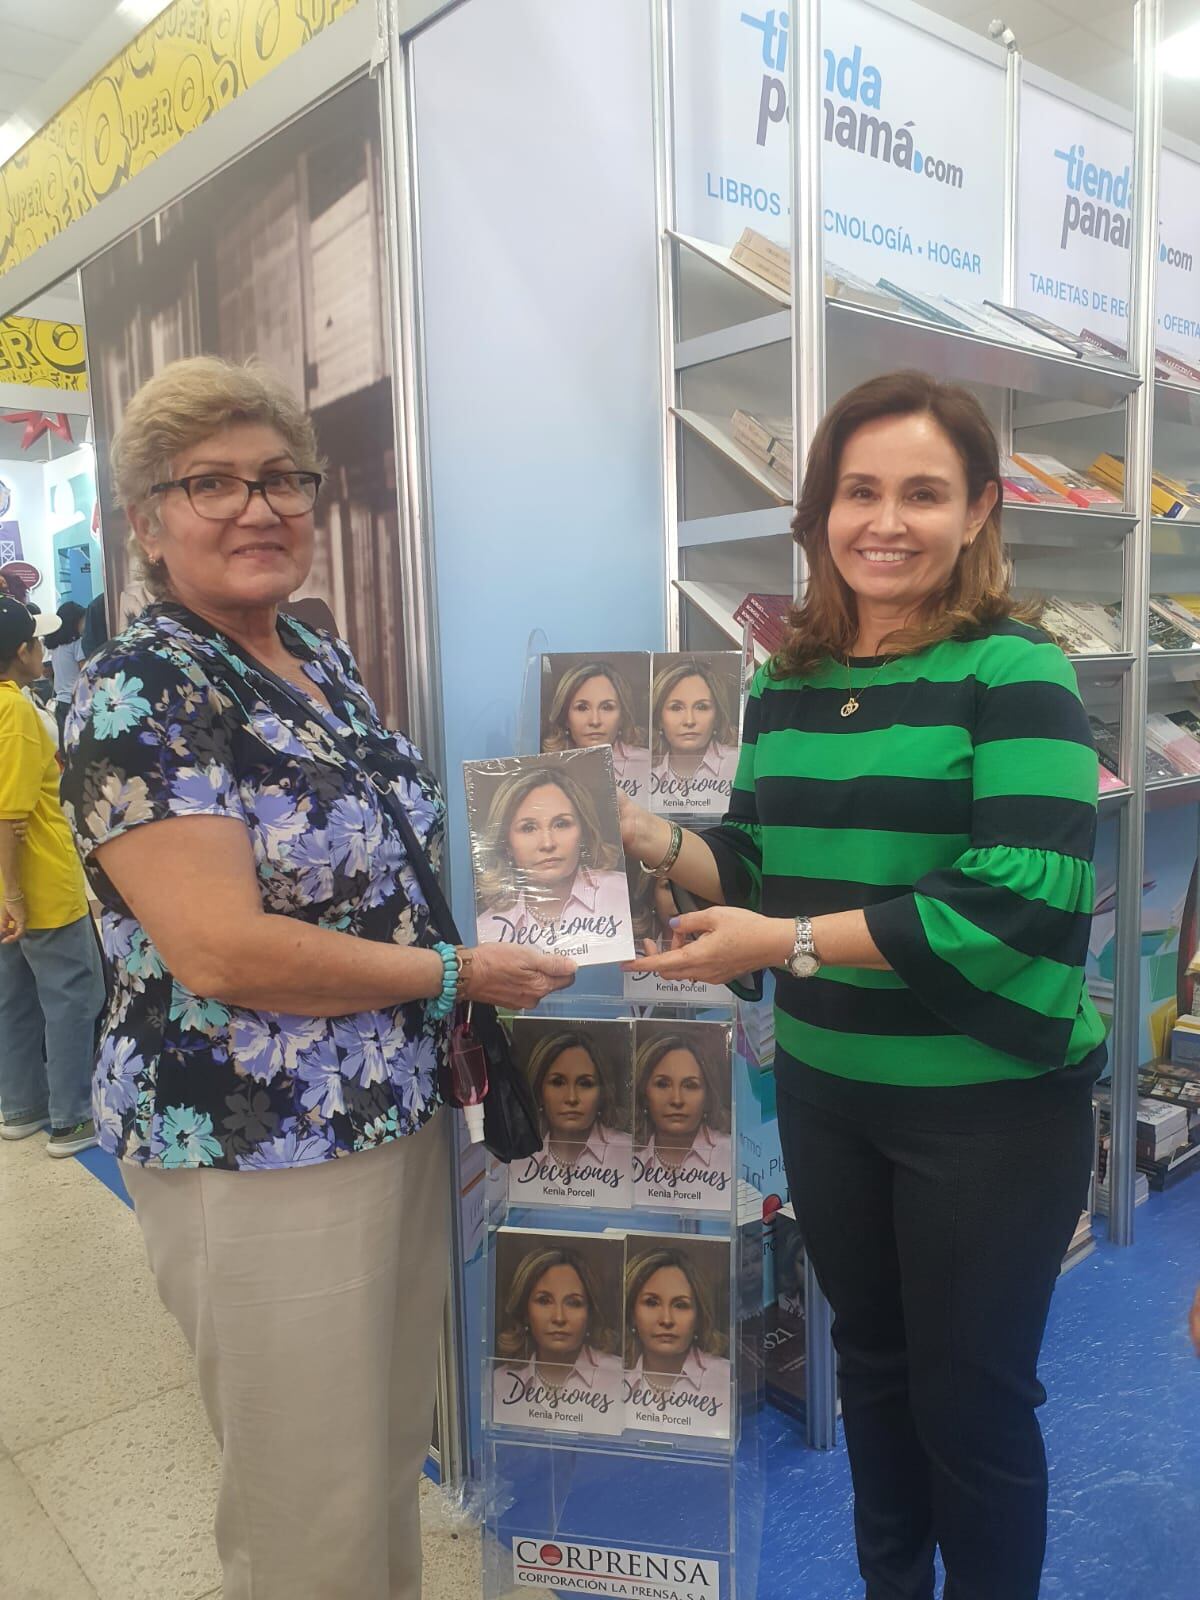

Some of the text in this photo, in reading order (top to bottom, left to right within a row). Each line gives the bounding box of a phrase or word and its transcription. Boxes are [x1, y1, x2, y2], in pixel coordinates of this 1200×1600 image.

[1054, 144, 1133, 210] tiend
[706, 172, 781, 216] LIBROS
[823, 208, 913, 255] CNOLOGÍA
[928, 240, 982, 274] HOGAR
[1030, 273, 1089, 307] TARJETAS
[1092, 292, 1108, 312] DE
[651, 772, 734, 797] Decisiones
[663, 799, 712, 807] Kenia Porcell
[492, 914, 623, 946] Decisiones
[554, 944, 589, 957] Porcell
[656, 983, 707, 992] Kenia Porcell
[518, 1156, 624, 1188] Decisiones
[632, 1156, 731, 1191] Decisiones
[543, 1187, 595, 1198] Kenia Porcell
[648, 1188, 701, 1200] Kenia Porcell
[502, 1372, 614, 1413] Decisiones
[528, 1409, 583, 1422] Kenia Porcell
[636, 1411, 691, 1426] Kenia Porcell
[516, 1540, 711, 1586] CORPRENSA
[612, 1584, 627, 1593] LA
